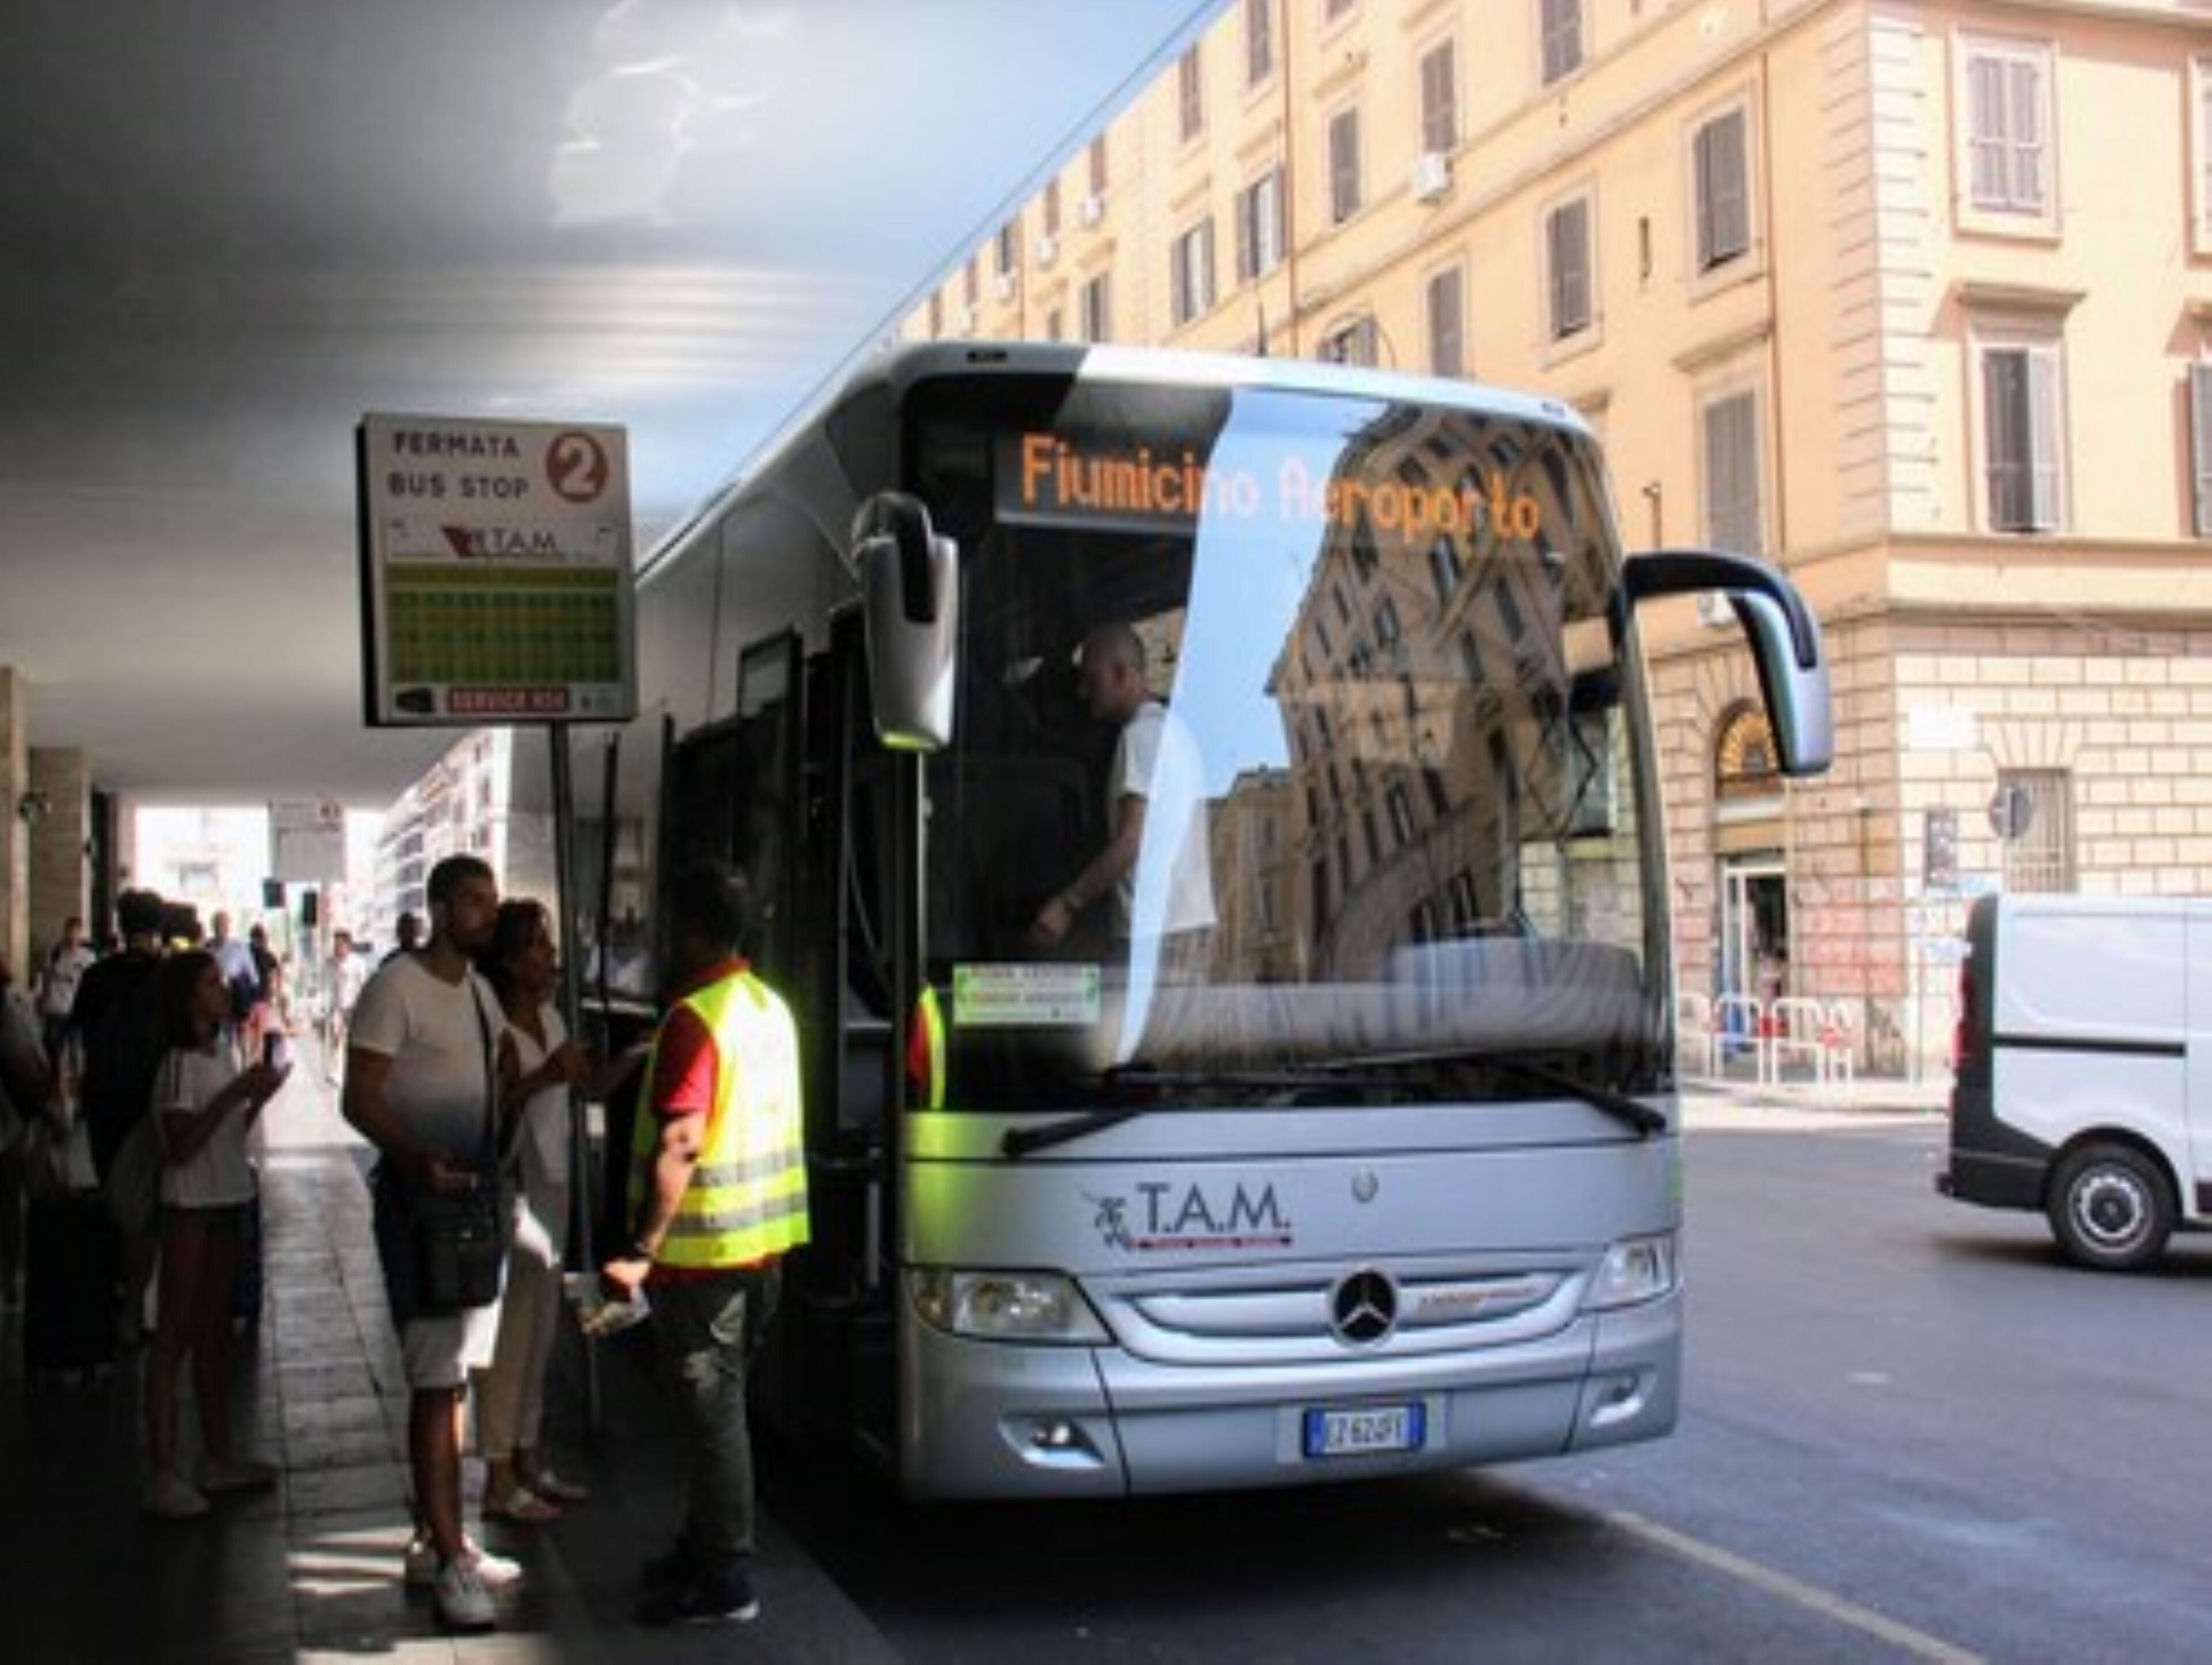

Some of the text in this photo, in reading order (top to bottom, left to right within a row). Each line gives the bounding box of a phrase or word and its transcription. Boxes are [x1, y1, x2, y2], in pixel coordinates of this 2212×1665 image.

[393, 432, 521, 457] FERMATA
[557, 434, 599, 494] 2
[388, 473, 529, 499] BUS STOP
[1023, 431, 1540, 544] Fiumicino Aeroporto
[1135, 1180, 1292, 1234] T.A.M.
